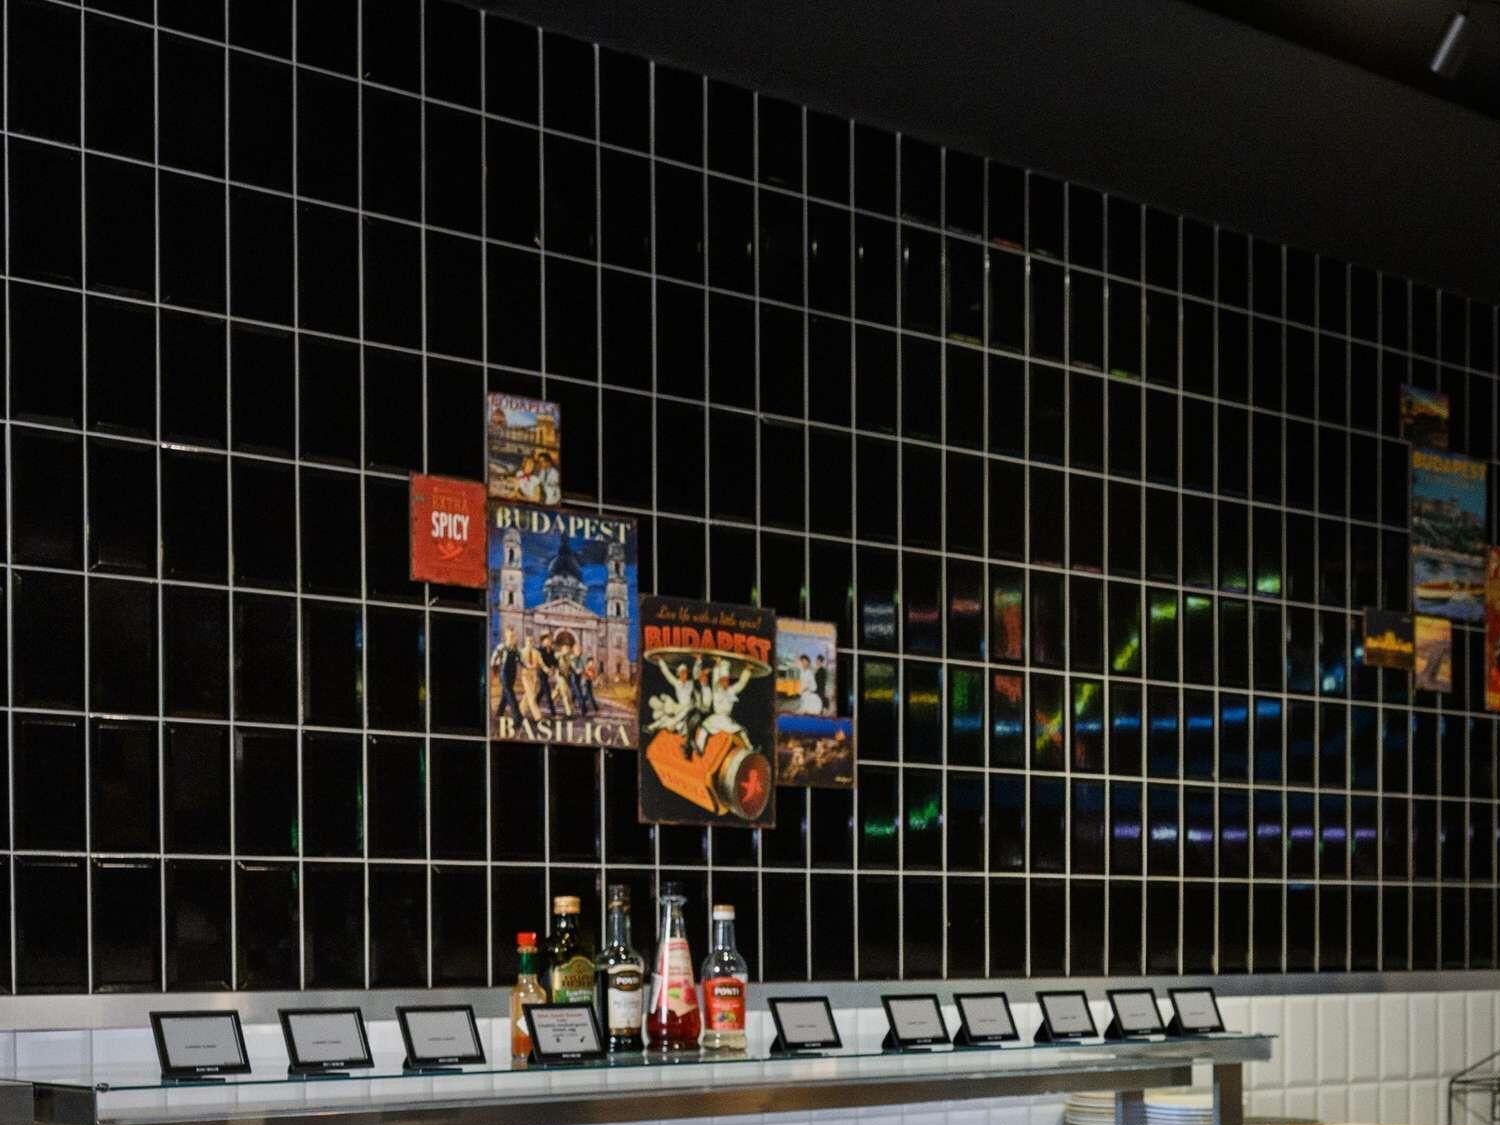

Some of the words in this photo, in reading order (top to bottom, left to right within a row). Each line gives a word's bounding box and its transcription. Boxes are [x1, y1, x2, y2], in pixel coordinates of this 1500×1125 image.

[431, 510, 470, 541] SPICY
[495, 506, 631, 544] BUDAPEST
[644, 625, 771, 664] BUDAPEST
[499, 716, 630, 746] BASILICA
